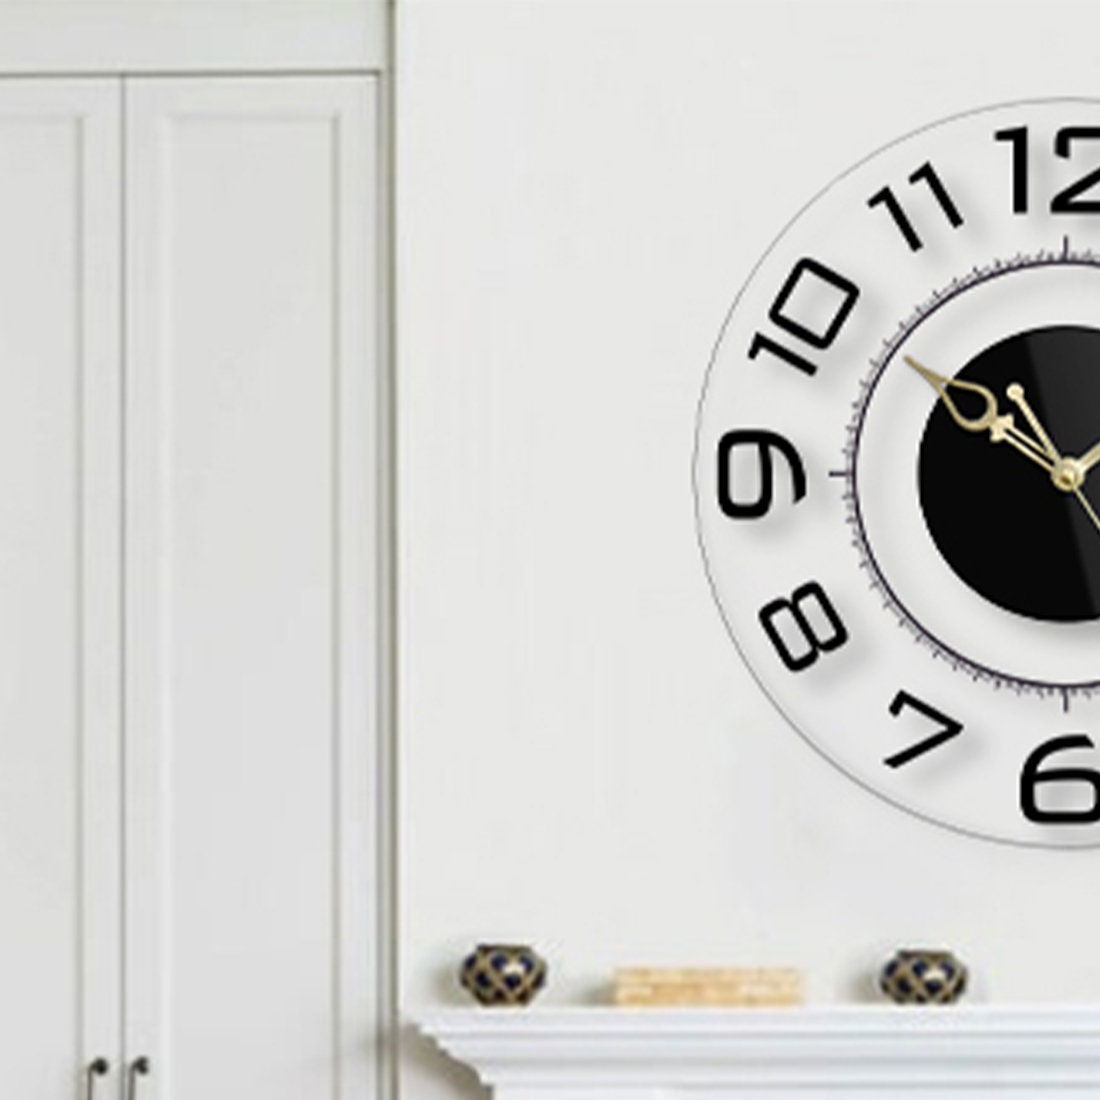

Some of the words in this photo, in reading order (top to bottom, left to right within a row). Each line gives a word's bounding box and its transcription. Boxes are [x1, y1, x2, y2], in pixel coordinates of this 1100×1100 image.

[867, 162, 964, 252] 11
[747, 257, 860, 377] 10
[717, 429, 807, 520] 9
[758, 581, 849, 673] 8
[884, 690, 964, 769] 7
